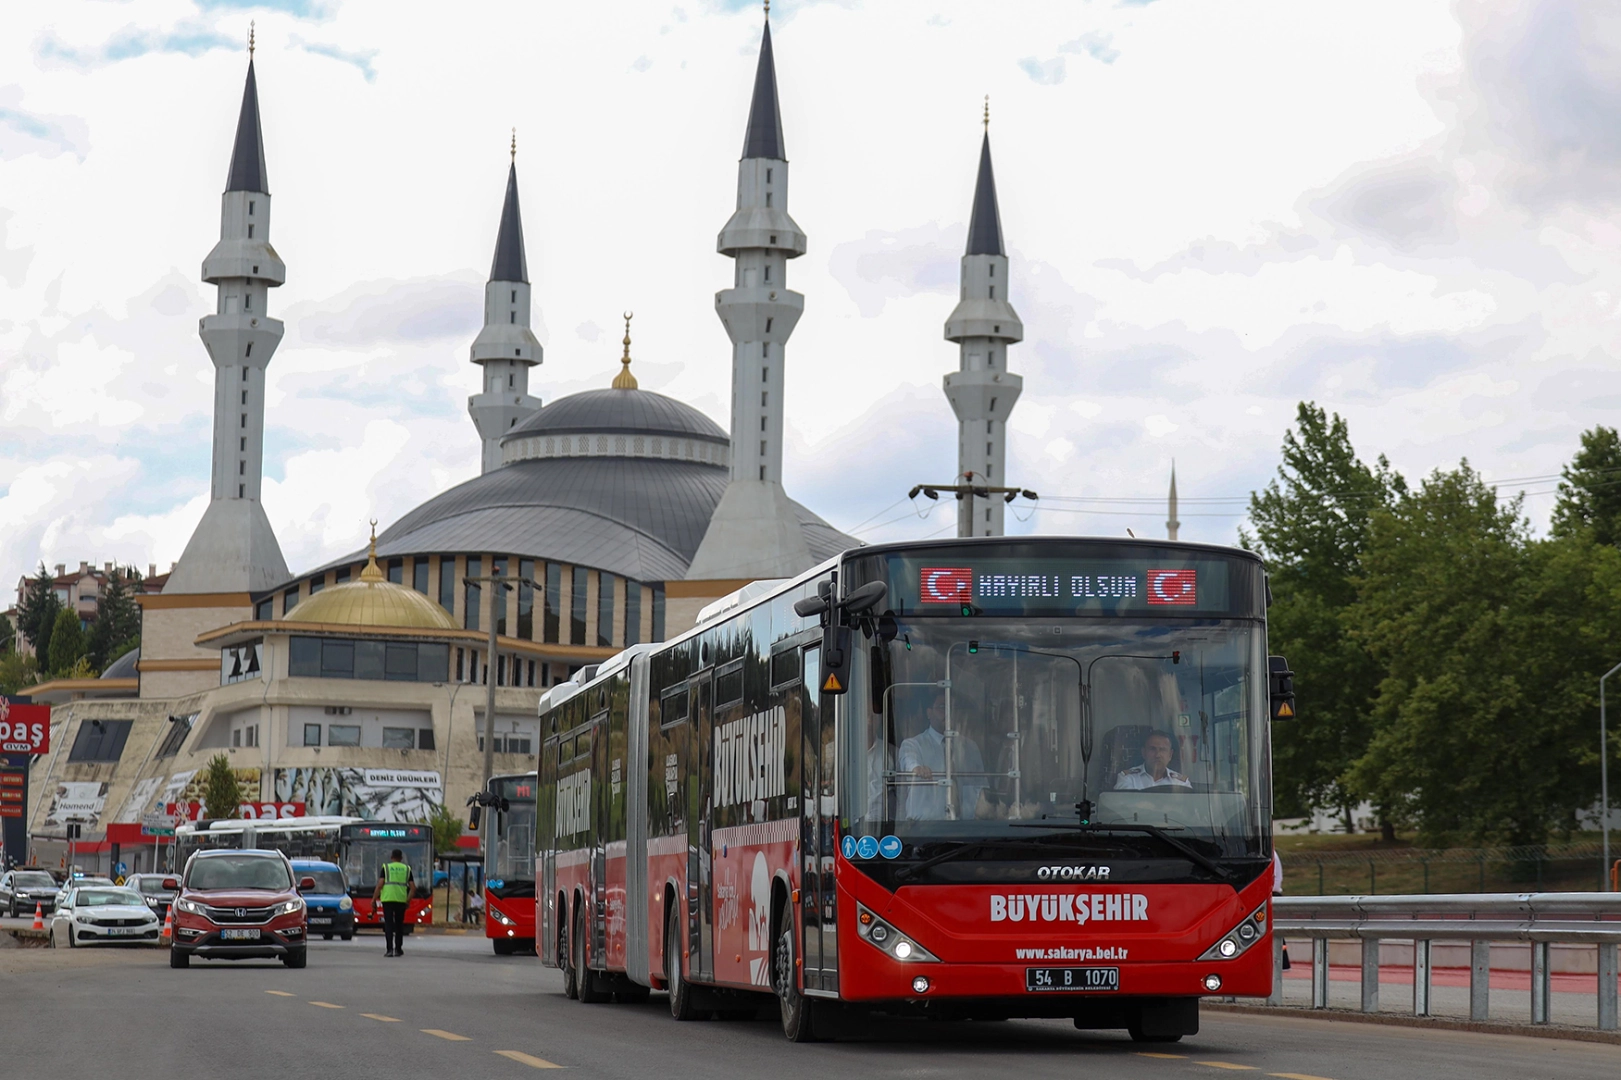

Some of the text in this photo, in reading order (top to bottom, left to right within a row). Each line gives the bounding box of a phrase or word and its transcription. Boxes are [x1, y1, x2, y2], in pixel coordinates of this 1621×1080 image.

[979, 575, 1137, 597] HAYIRLI OLSUN
[370, 773, 395, 782] DENİZ
[1037, 866, 1111, 880] OTOKAR
[990, 893, 1149, 926] BÜYÜKŞEHİR
[1016, 946, 1128, 961] www.sakarya.bel.tr
[1035, 970, 1117, 985] 54 B 1070
